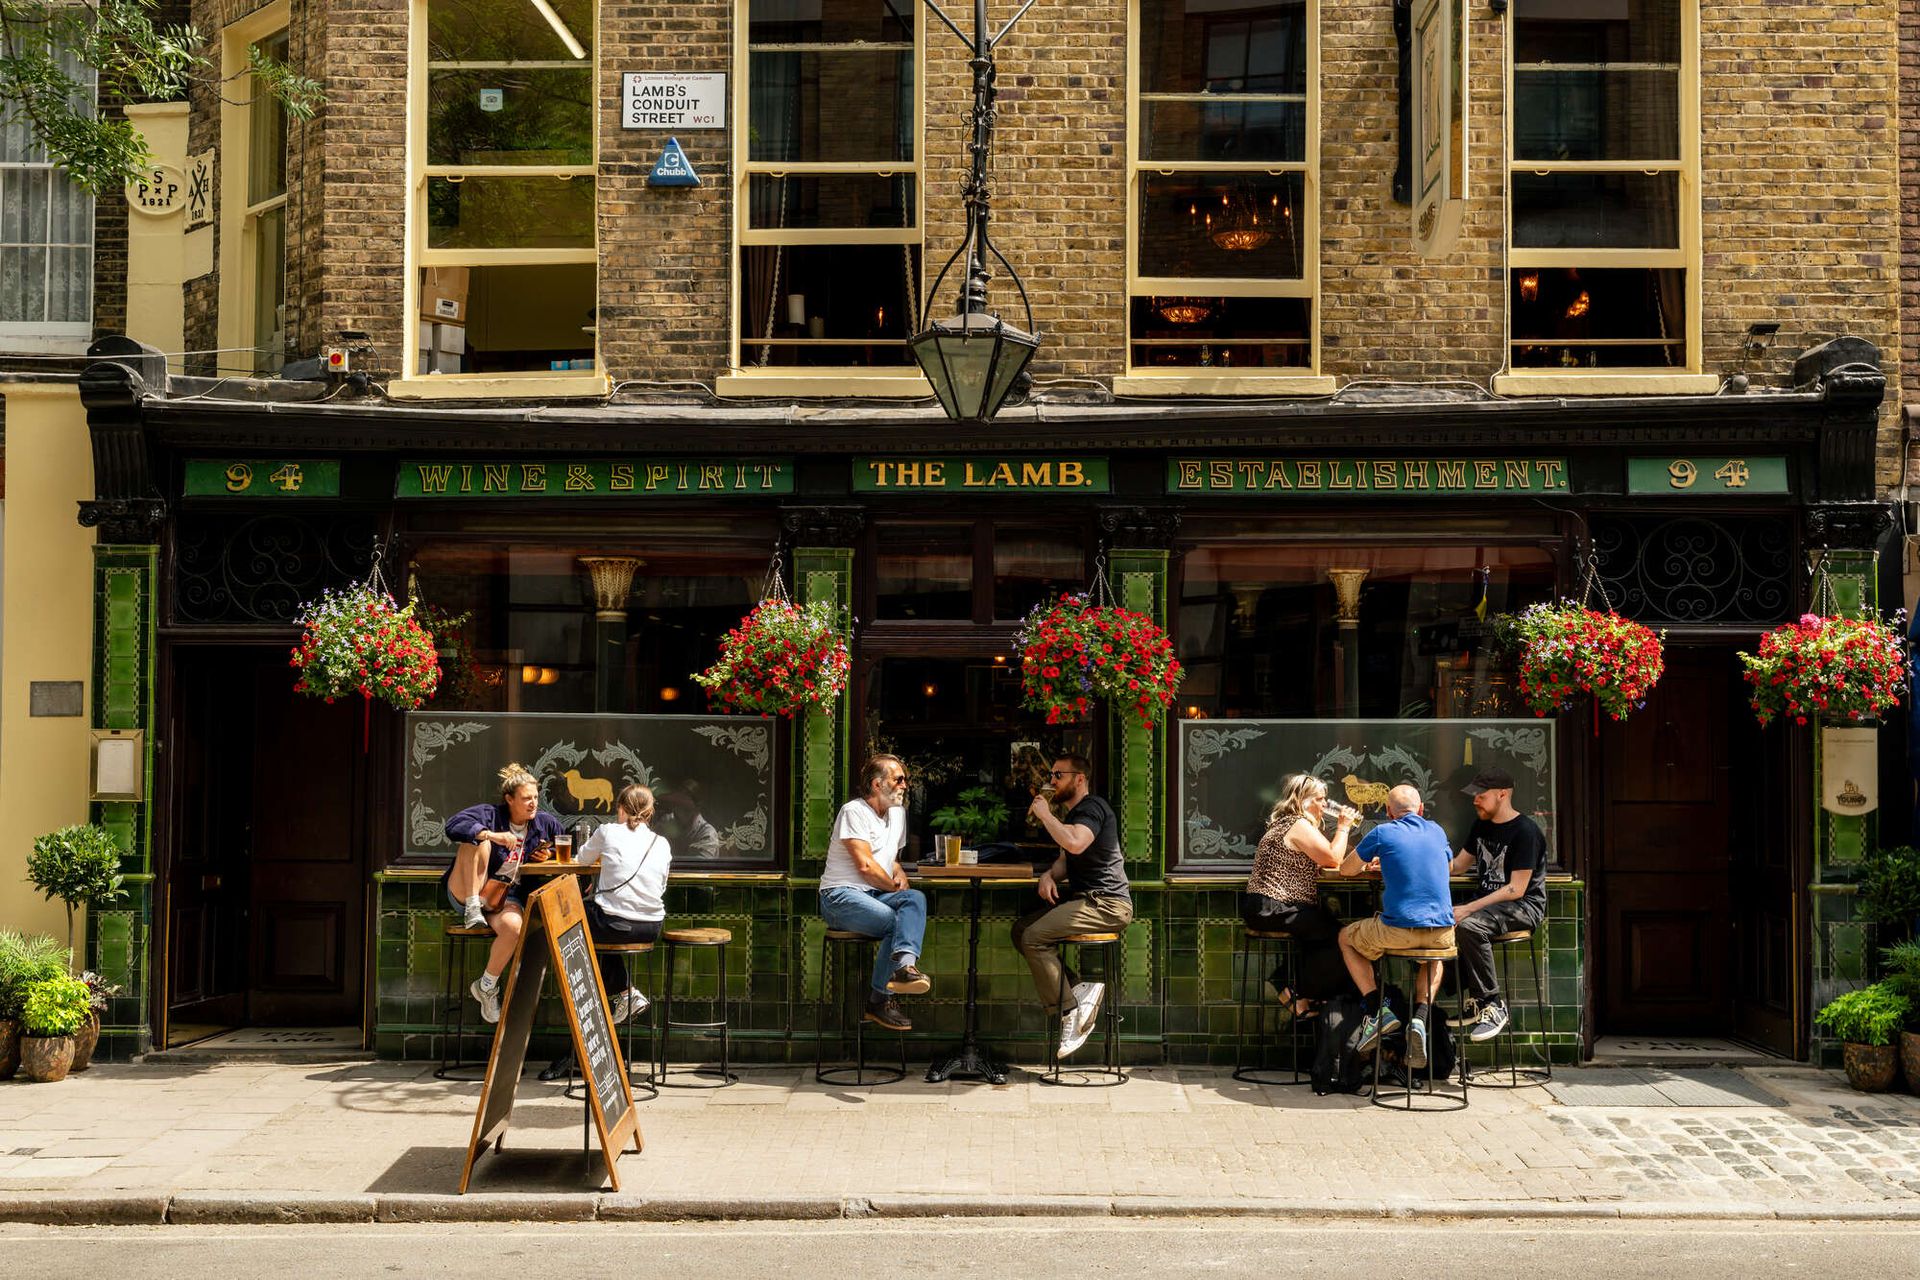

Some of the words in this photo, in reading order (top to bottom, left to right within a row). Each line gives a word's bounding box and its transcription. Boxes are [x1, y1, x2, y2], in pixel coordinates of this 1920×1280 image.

[632, 84, 687, 97] LAMB'S
[632, 99, 700, 111] CONDUIT
[632, 112, 685, 124] STREET
[693, 115, 715, 124] WC1
[153, 171, 164, 184] S
[656, 167, 687, 177] Chubb
[138, 184, 149, 198] P
[168, 184, 178, 198] P
[141, 198, 171, 207] 1821
[418, 465, 546, 492] WINE
[565, 464, 597, 491] &
[610, 463, 782, 490] SPIRIT
[869, 462, 946, 487] THE
[962, 462, 1093, 487] LAMB.
[1178, 461, 1567, 489] ESTABLISHMENT.
